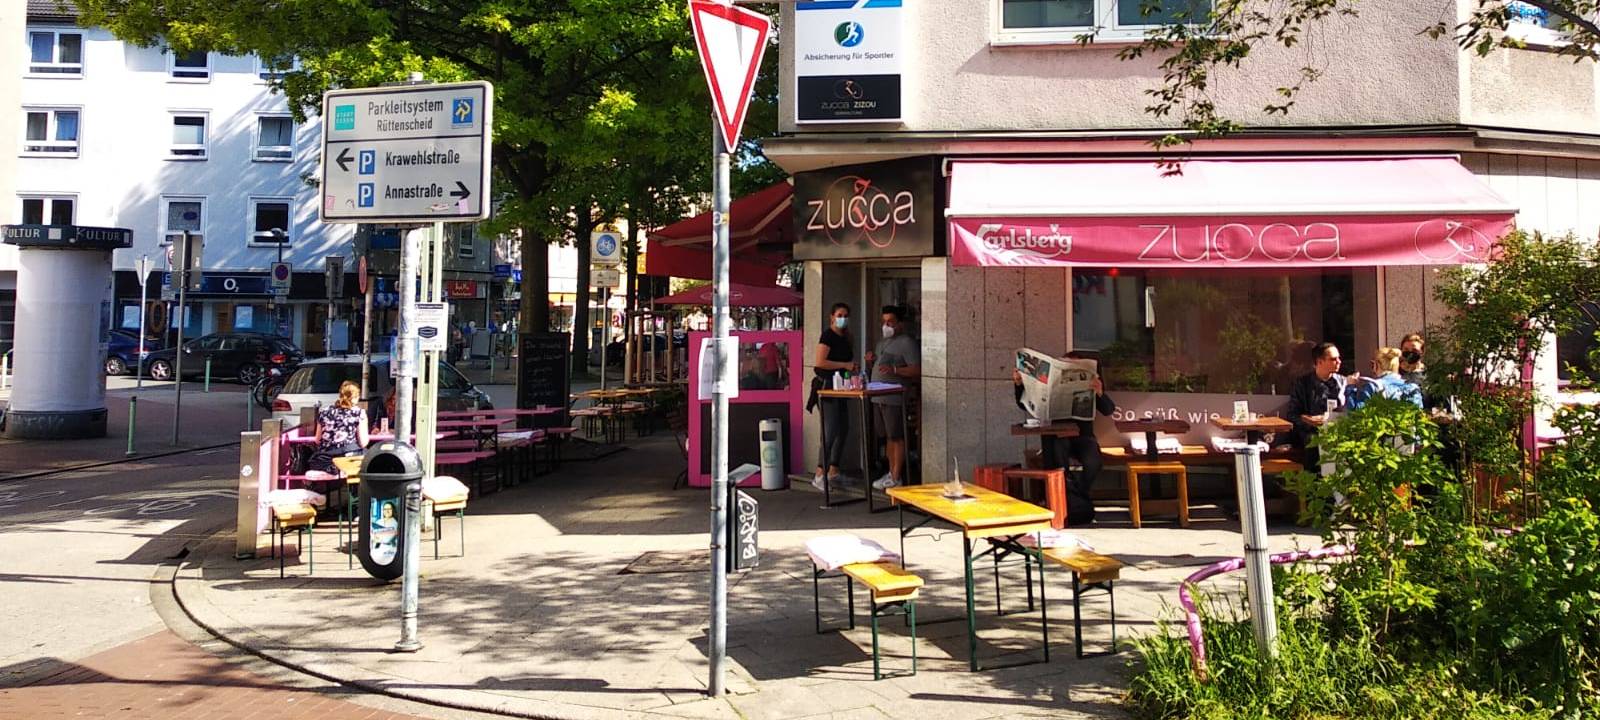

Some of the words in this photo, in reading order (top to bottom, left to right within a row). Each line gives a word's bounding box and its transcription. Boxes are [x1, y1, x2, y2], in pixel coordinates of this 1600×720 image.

[804, 52, 850, 61] Absicherung
[852, 51, 863, 59] für
[865, 51, 894, 60] Sportler
[368, 99, 444, 116] Parkleitsystem
[376, 117, 433, 132] Rüttenscheid
[361, 153, 373, 172] P
[385, 149, 460, 167] Krawehlstraße
[361, 185, 372, 205] P
[385, 183, 443, 200] Annastraße
[806, 191, 916, 231] zucca
[76, 227, 121, 240] KULTUR
[976, 223, 1073, 254] Carlsberg
[1137, 222, 1346, 262] zucca
[1112, 407, 1136, 421] So
